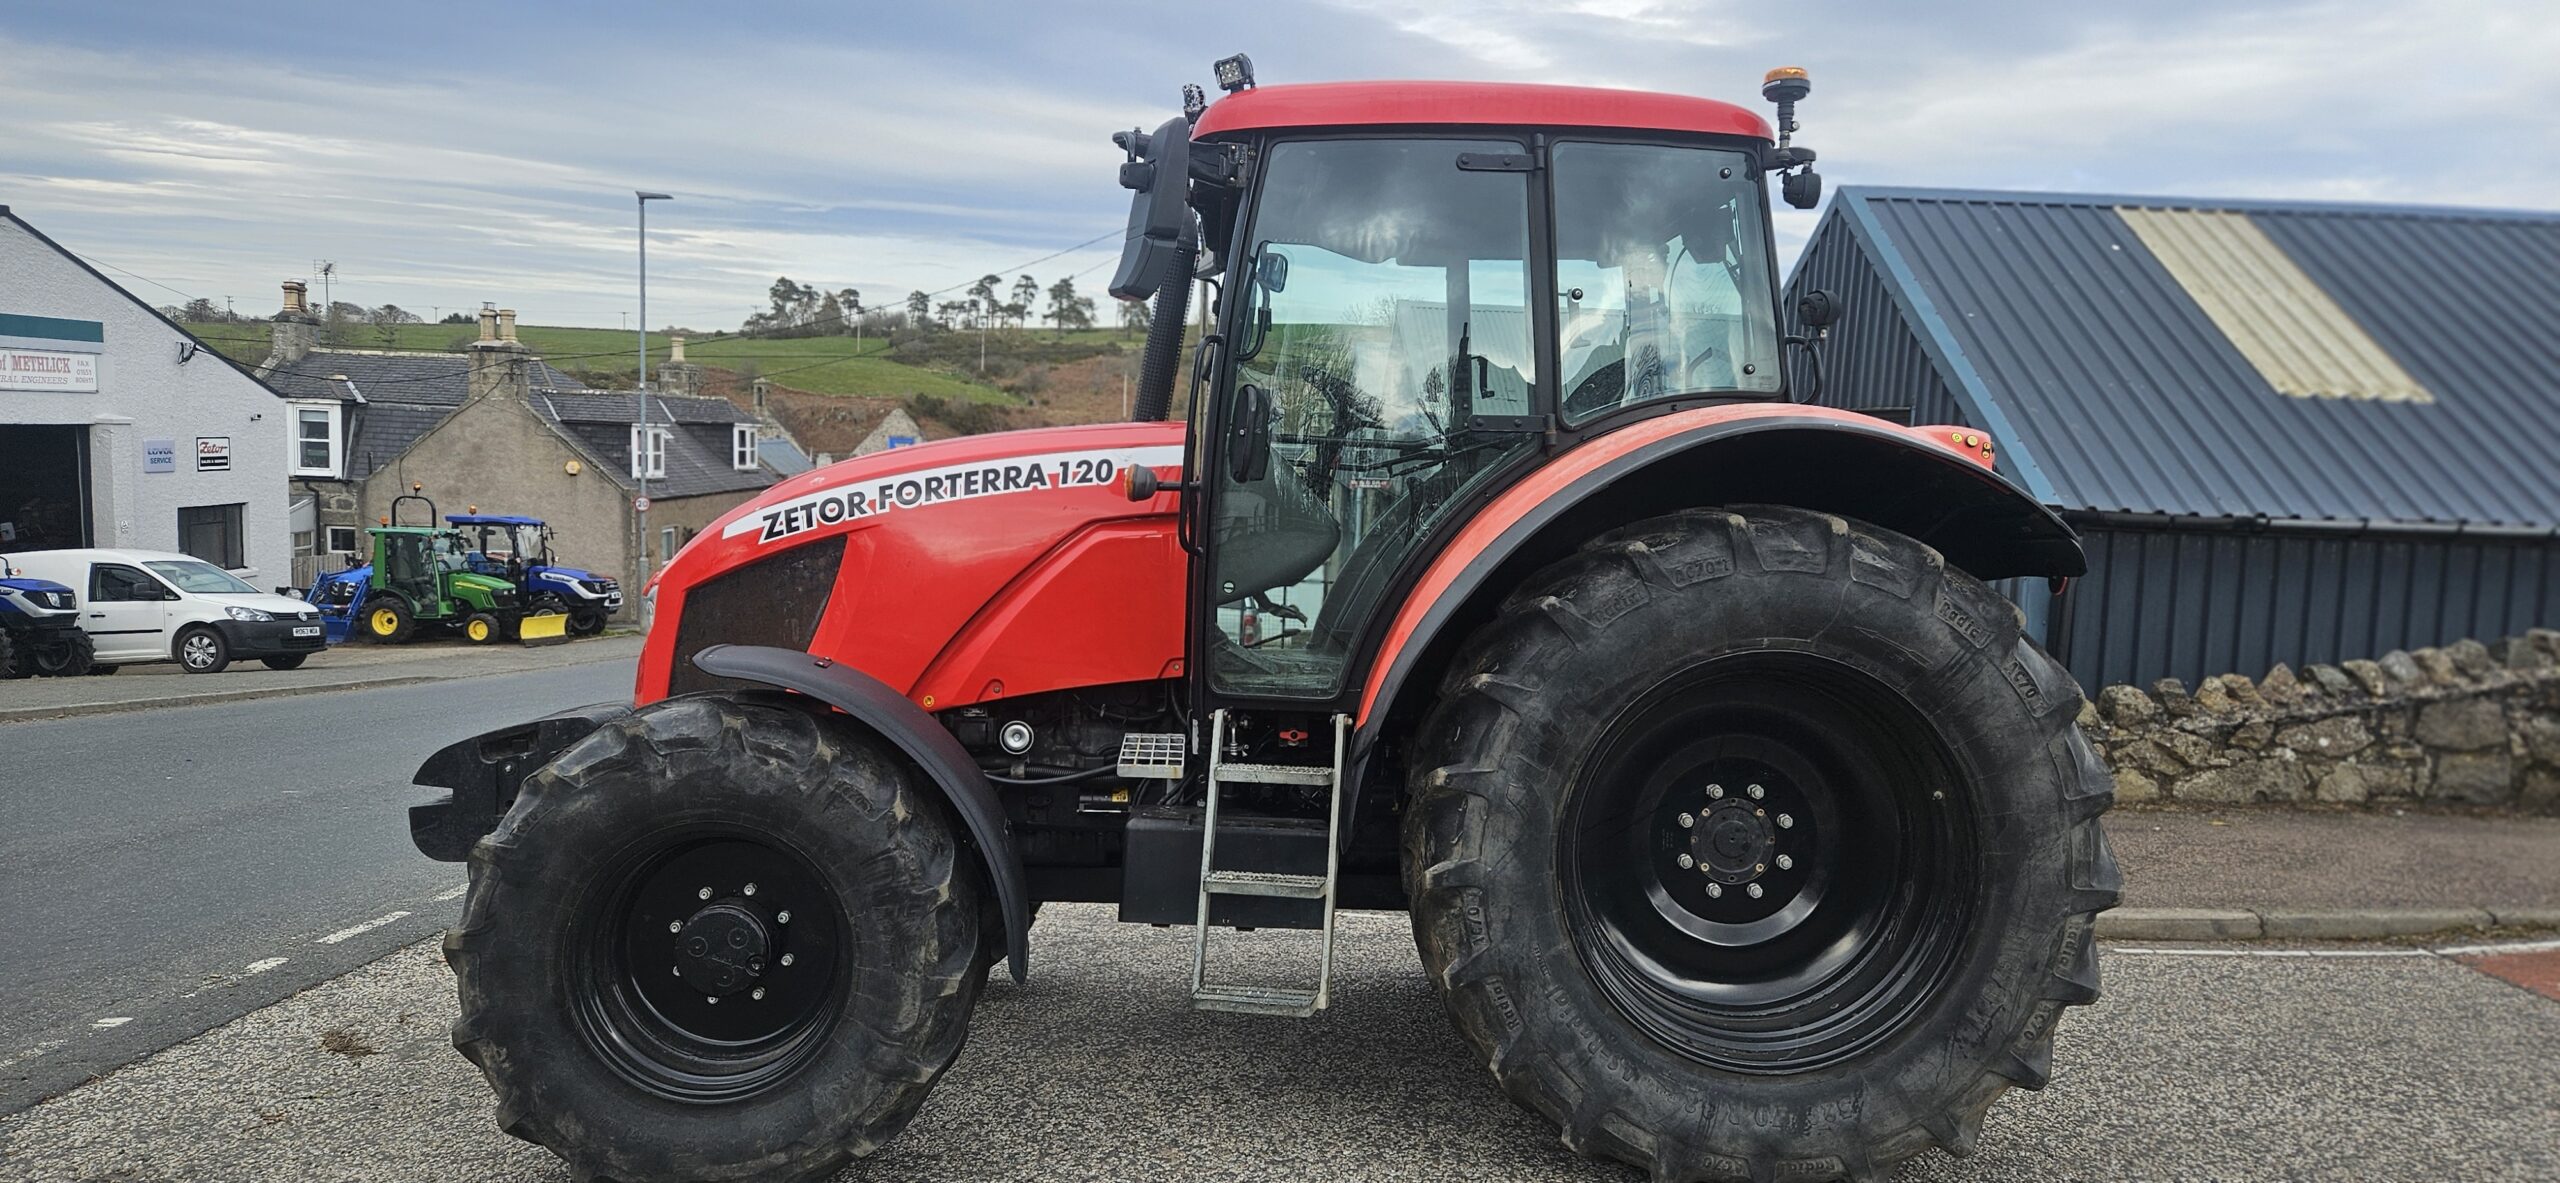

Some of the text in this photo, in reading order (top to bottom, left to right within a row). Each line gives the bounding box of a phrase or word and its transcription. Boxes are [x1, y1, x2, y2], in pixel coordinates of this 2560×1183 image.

[11, 355, 71, 374] METHLICK
[21, 375, 68, 385] ENGINEERS
[200, 441, 228, 454] Zetor
[150, 457, 172, 465] SERVICE
[761, 458, 1114, 541] ZETOR FORTERRA 120
